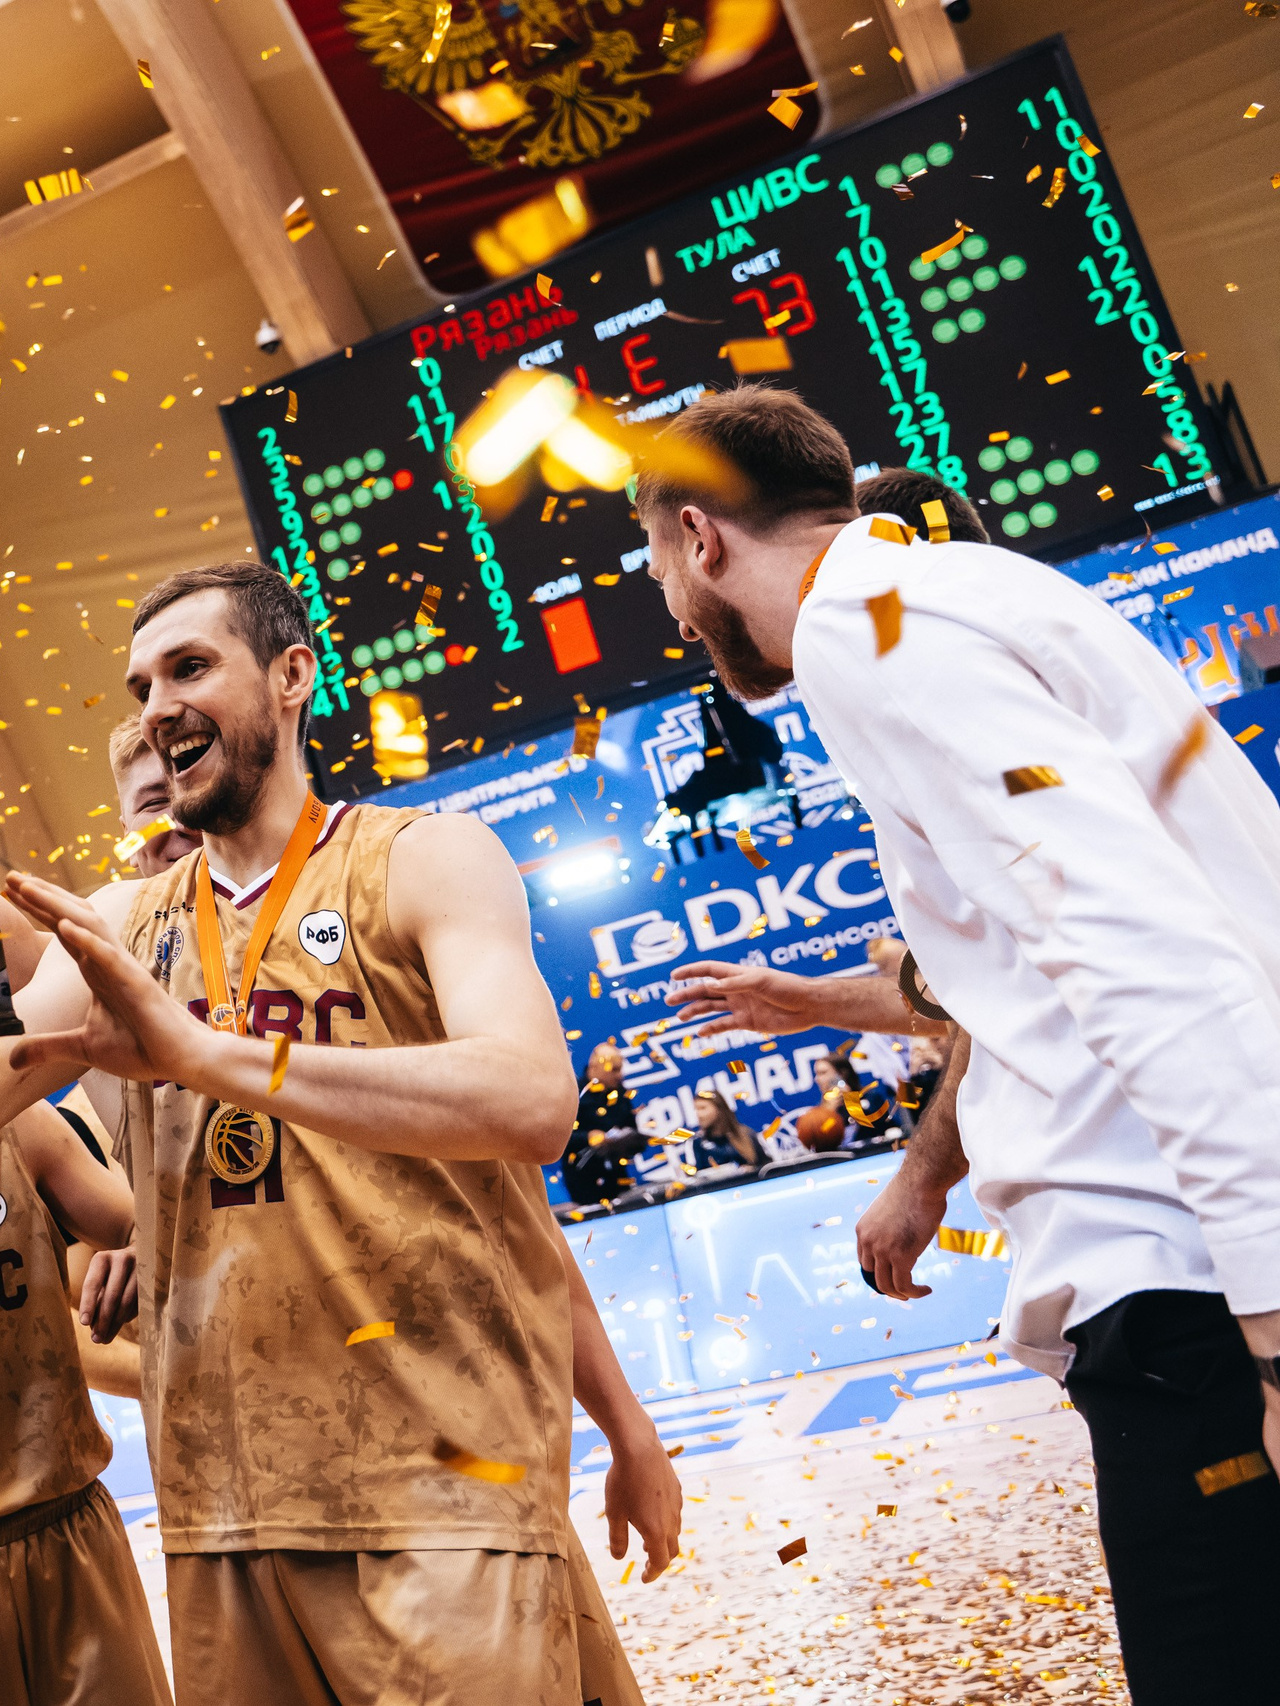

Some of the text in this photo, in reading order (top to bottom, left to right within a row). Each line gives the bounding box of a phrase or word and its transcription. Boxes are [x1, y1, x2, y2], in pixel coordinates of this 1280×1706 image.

[1017, 86, 1068, 130] 11
[1055, 118, 1084, 151] 0
[1068, 150, 1097, 183] 0
[711, 154, 829, 228] ЦИВС
[838, 175, 861, 206] 1
[1078, 181, 1112, 218] 2
[846, 204, 870, 237] 7
[1093, 213, 1122, 246] 0
[676, 226, 756, 273] ТУЛА
[731, 248, 781, 283] СЧЕТ
[836, 237, 887, 279] 10
[1078, 245, 1137, 288] 12
[733, 272, 817, 338] 73
[847, 267, 895, 311] 11
[1087, 277, 1150, 326] 22
[594, 298, 667, 341] ПЕРИОД
[858, 298, 910, 340] 13
[1130, 310, 1160, 345] 0
[518, 340, 563, 371] СЧЕТ
[869, 328, 921, 371] 15
[1143, 343, 1172, 377] 0
[419, 357, 441, 387] 0
[880, 358, 927, 402] 17
[1154, 374, 1186, 412] 5
[417, 411, 455, 451] 17
[889, 392, 944, 438] 23
[1166, 408, 1199, 443] 8
[258, 428, 281, 457] 2
[900, 421, 950, 470] 27
[266, 454, 289, 482] 3
[1153, 443, 1212, 487] 13
[273, 481, 296, 512] 5
[281, 511, 304, 541] 9
[462, 503, 488, 534] 2
[471, 530, 495, 561] 0
[1168, 527, 1279, 578] КОМАНД
[480, 560, 504, 590] 0
[489, 590, 513, 622] 9
[497, 619, 524, 652] 2
[312, 681, 350, 717] 41
[684, 848, 888, 952] DKC
[771, 915, 900, 965] спонсор
